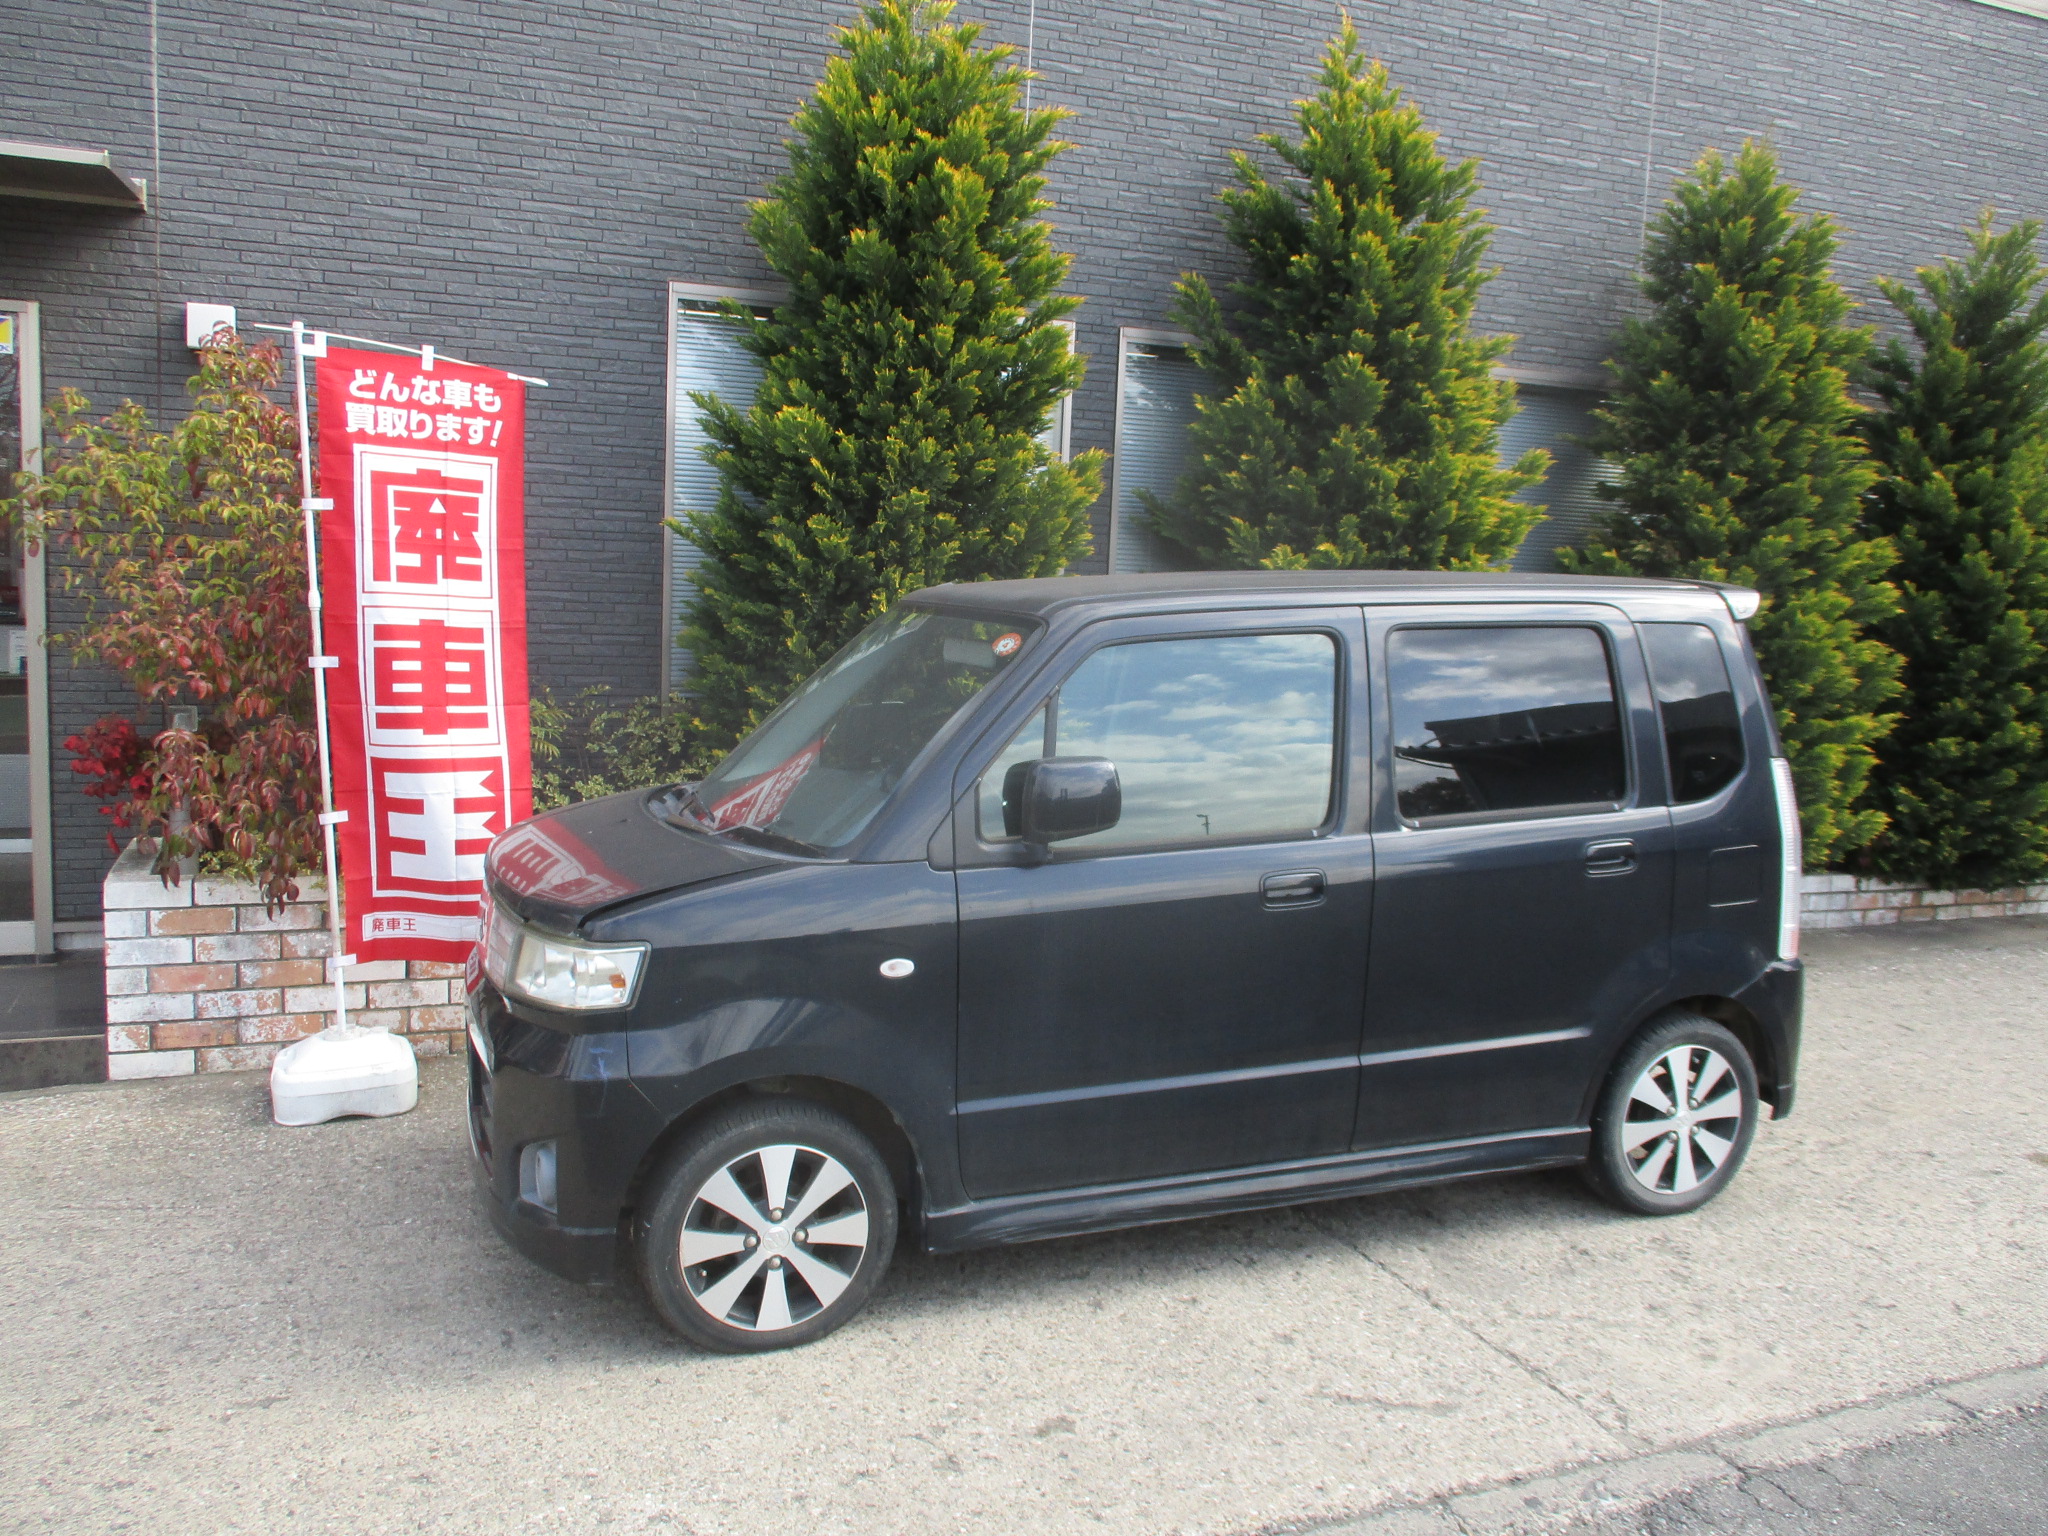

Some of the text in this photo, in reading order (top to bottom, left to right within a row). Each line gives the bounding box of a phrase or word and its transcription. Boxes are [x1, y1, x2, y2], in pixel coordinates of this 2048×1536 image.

[349, 369, 502, 412] どんな車も
[345, 402, 503, 447] 買取ります!
[370, 468, 497, 881] 廃車王
[372, 917, 417, 932] 廃車王
